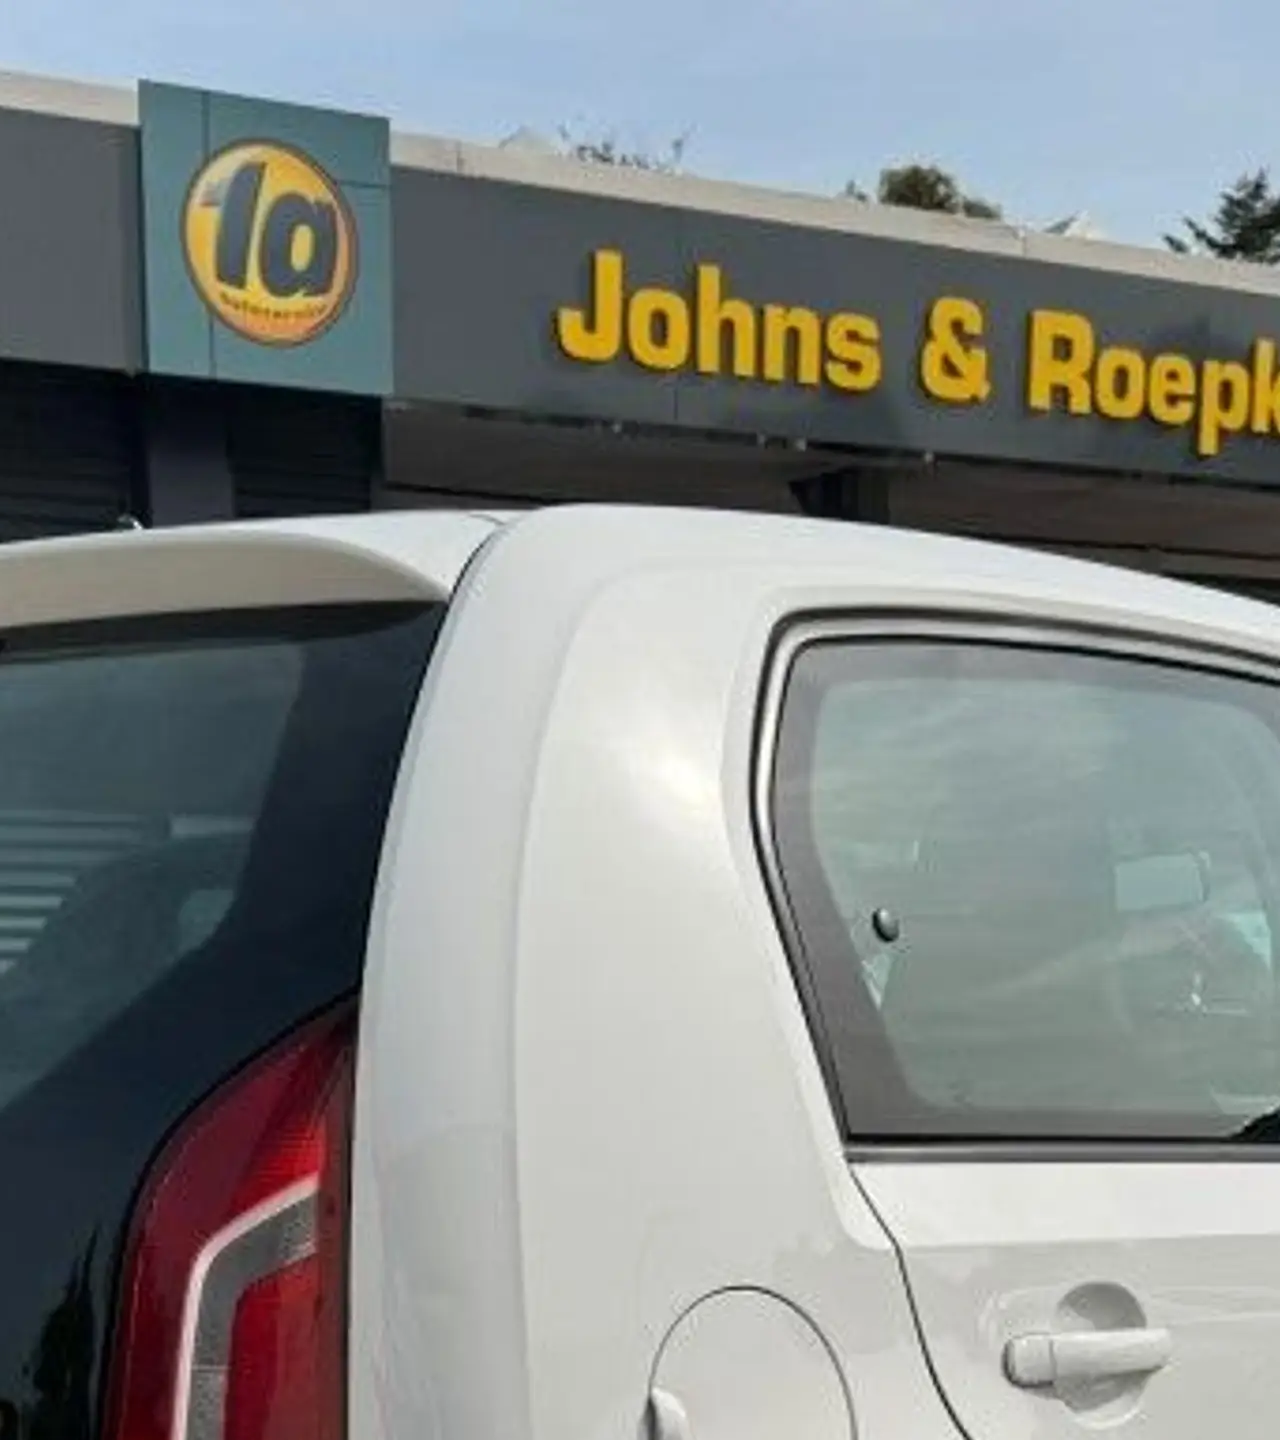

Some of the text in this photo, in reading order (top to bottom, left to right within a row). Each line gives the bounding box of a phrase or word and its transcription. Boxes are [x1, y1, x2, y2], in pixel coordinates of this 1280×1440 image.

[199, 162, 338, 298] 1a
[557, 248, 883, 393] Johns
[921, 296, 992, 401] &
